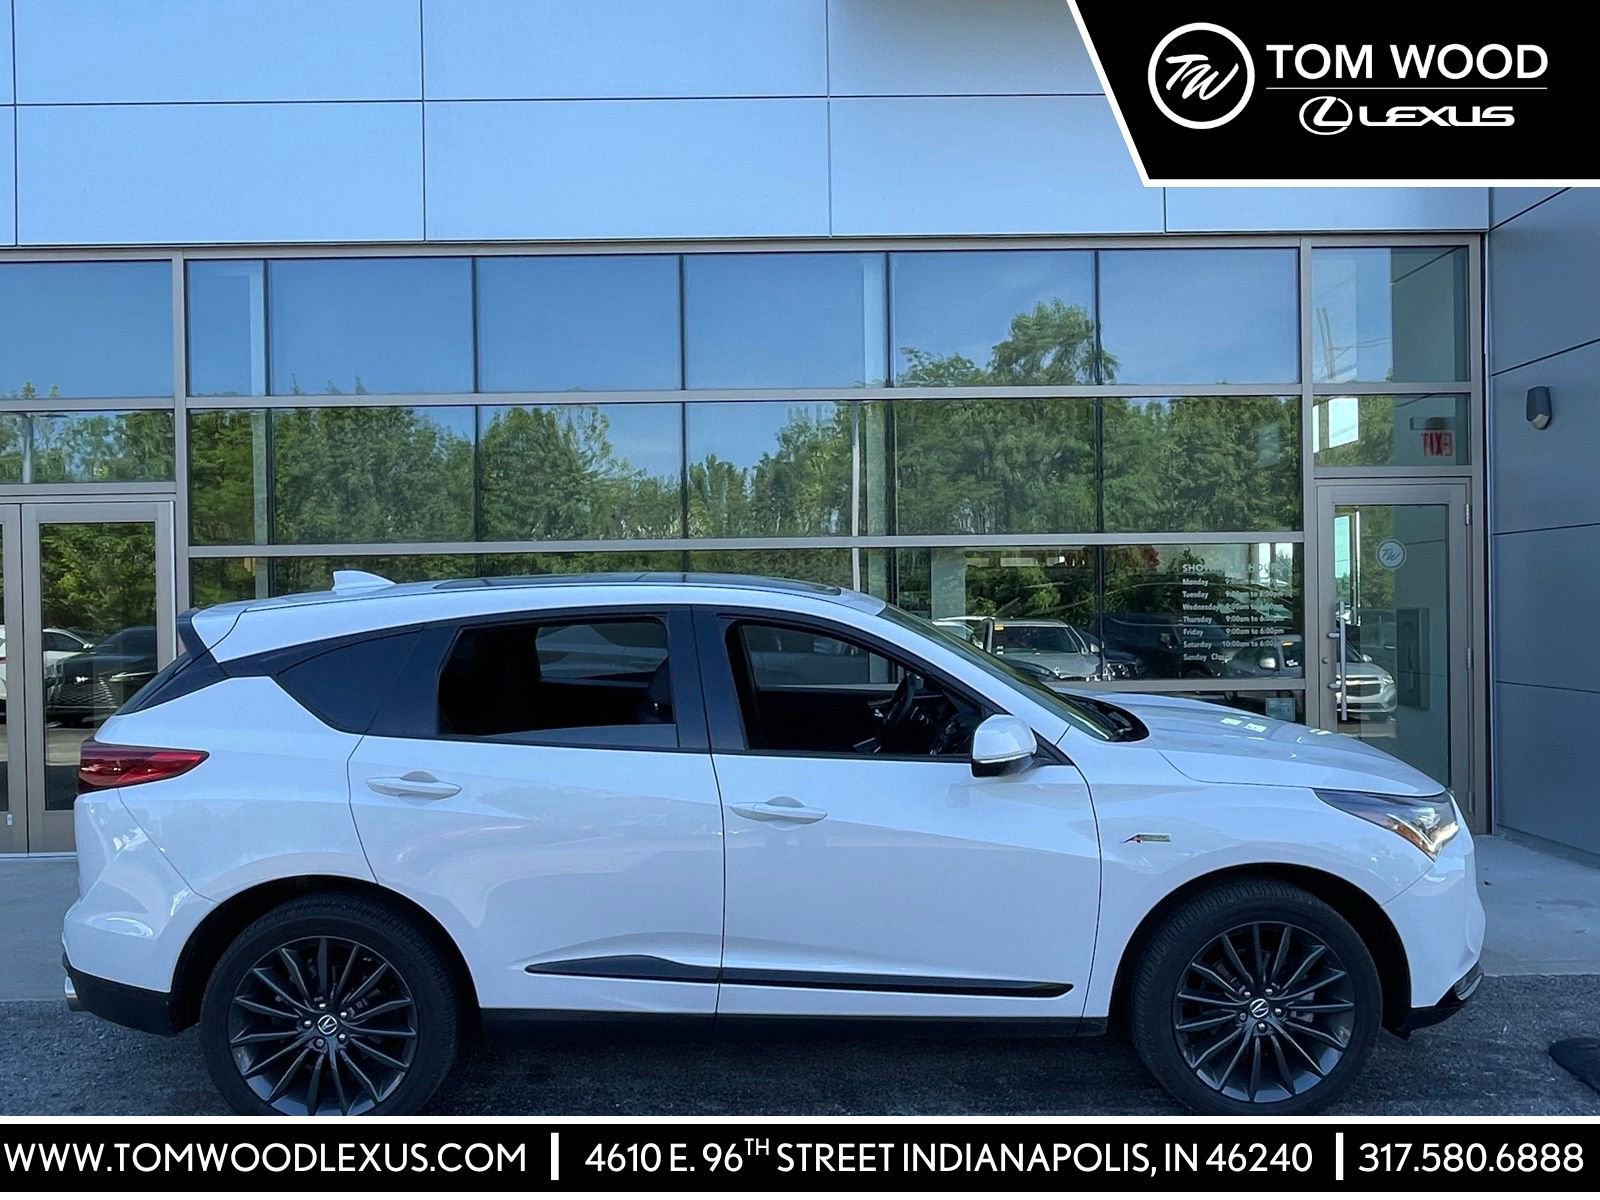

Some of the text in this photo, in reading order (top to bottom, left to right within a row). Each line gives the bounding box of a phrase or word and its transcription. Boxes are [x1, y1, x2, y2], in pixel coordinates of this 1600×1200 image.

[1182, 578, 1209, 587] Monday
[1182, 591, 1209, 599] Tuesday
[1182, 603, 1219, 612] Wednesday
[1183, 616, 1213, 624] Thursday
[1183, 628, 1204, 636] Friday
[1183, 641, 1212, 649] Saturday
[1183, 654, 1207, 662] Sunday
